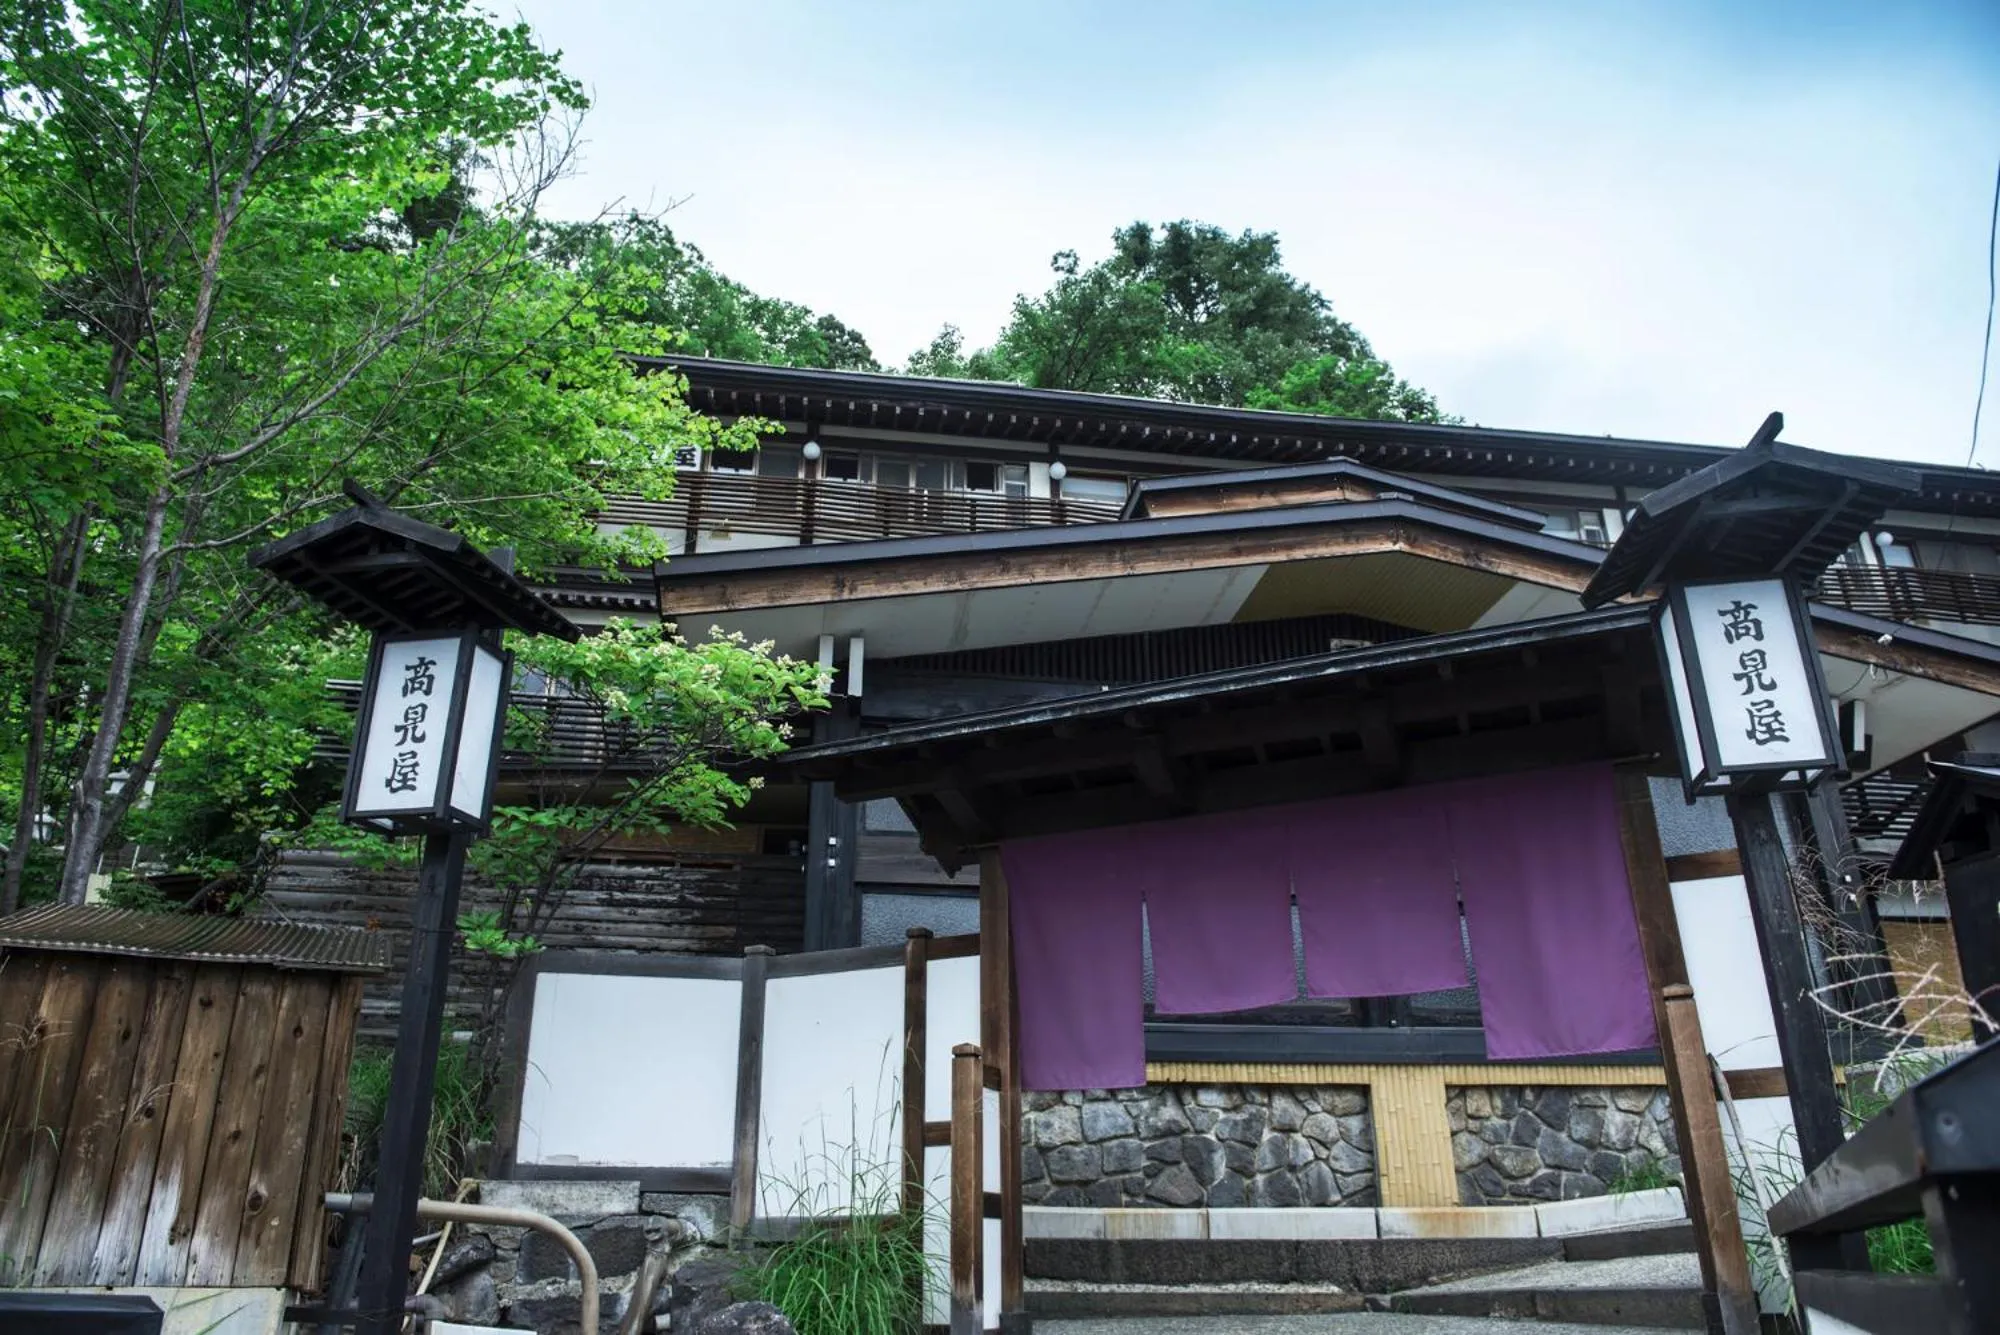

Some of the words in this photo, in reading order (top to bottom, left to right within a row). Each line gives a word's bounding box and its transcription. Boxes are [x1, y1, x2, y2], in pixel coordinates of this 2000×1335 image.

[385, 657, 437, 792] 高見屋
[1717, 600, 1789, 745] 高見屋
